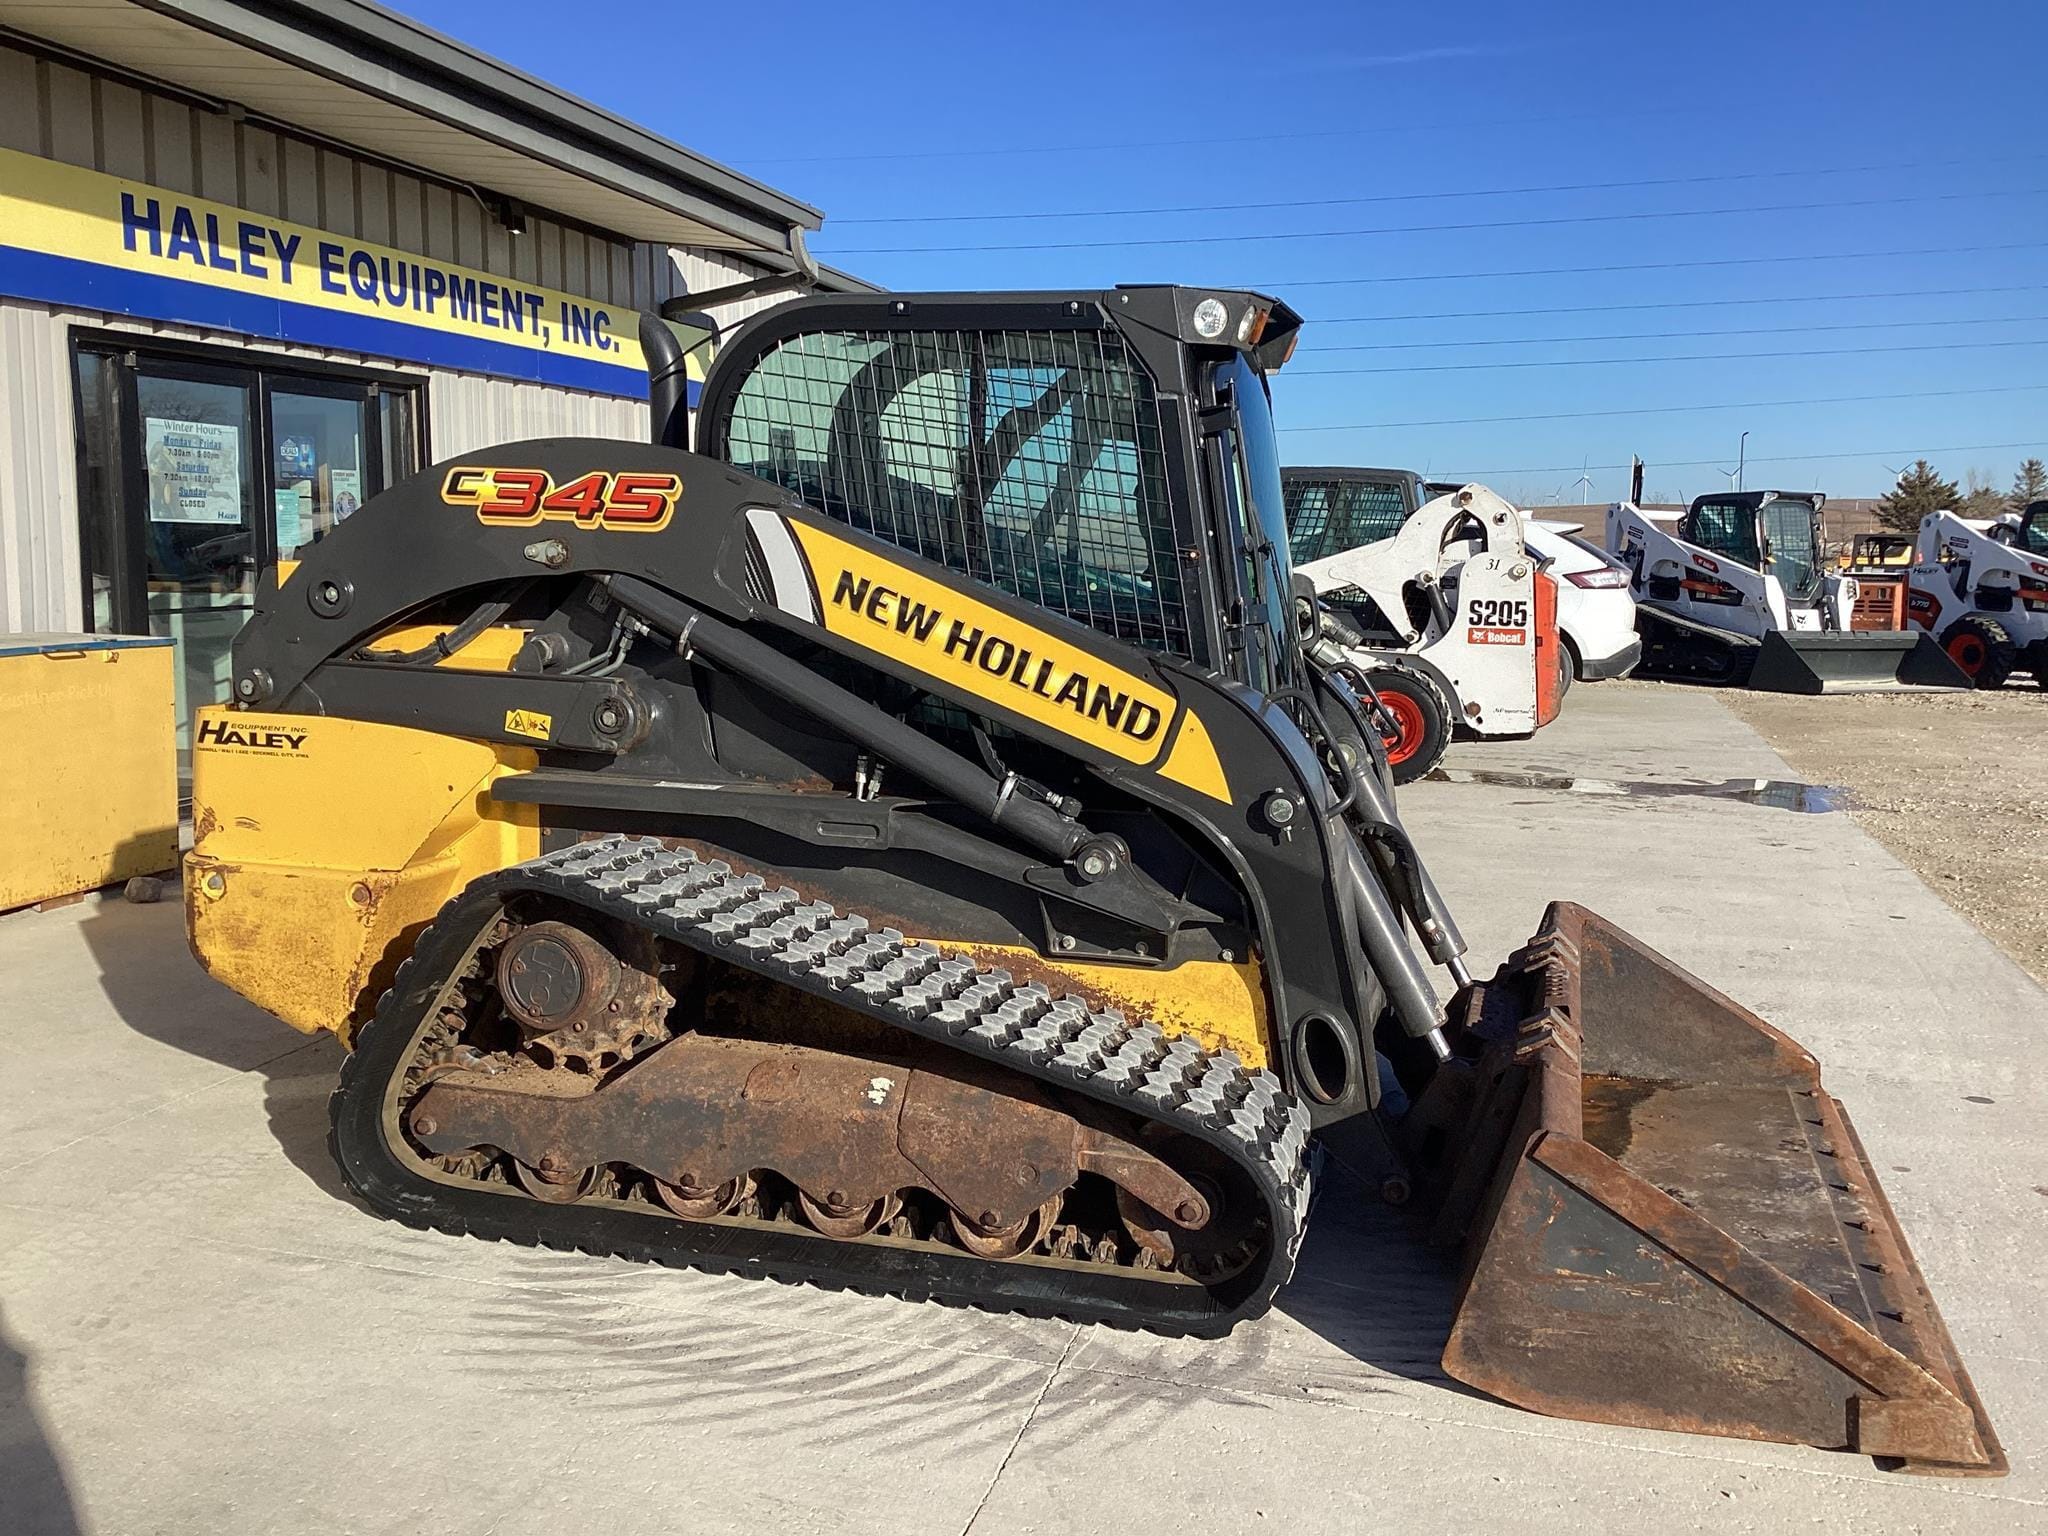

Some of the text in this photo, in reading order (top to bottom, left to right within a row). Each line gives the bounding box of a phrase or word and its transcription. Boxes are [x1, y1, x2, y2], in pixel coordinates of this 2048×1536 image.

[120, 191, 621, 353] HALEY EQUIPMENT, INC.
[163, 420, 223, 436] Winter Hours
[163, 434, 222, 450] Monday Friday
[176, 462, 209, 473] Saturday
[178, 486, 208, 498] Sunday
[444, 468, 680, 528] C345
[180, 499, 206, 508] CLOSED
[1485, 558, 1501, 571] 31
[1468, 599, 1528, 627] S205
[1487, 630, 1523, 644] Bobcat
[832, 568, 1161, 742] NEW HOLLAND
[197, 719, 309, 750] HALEY
[230, 723, 287, 733] EQUIPMENT
